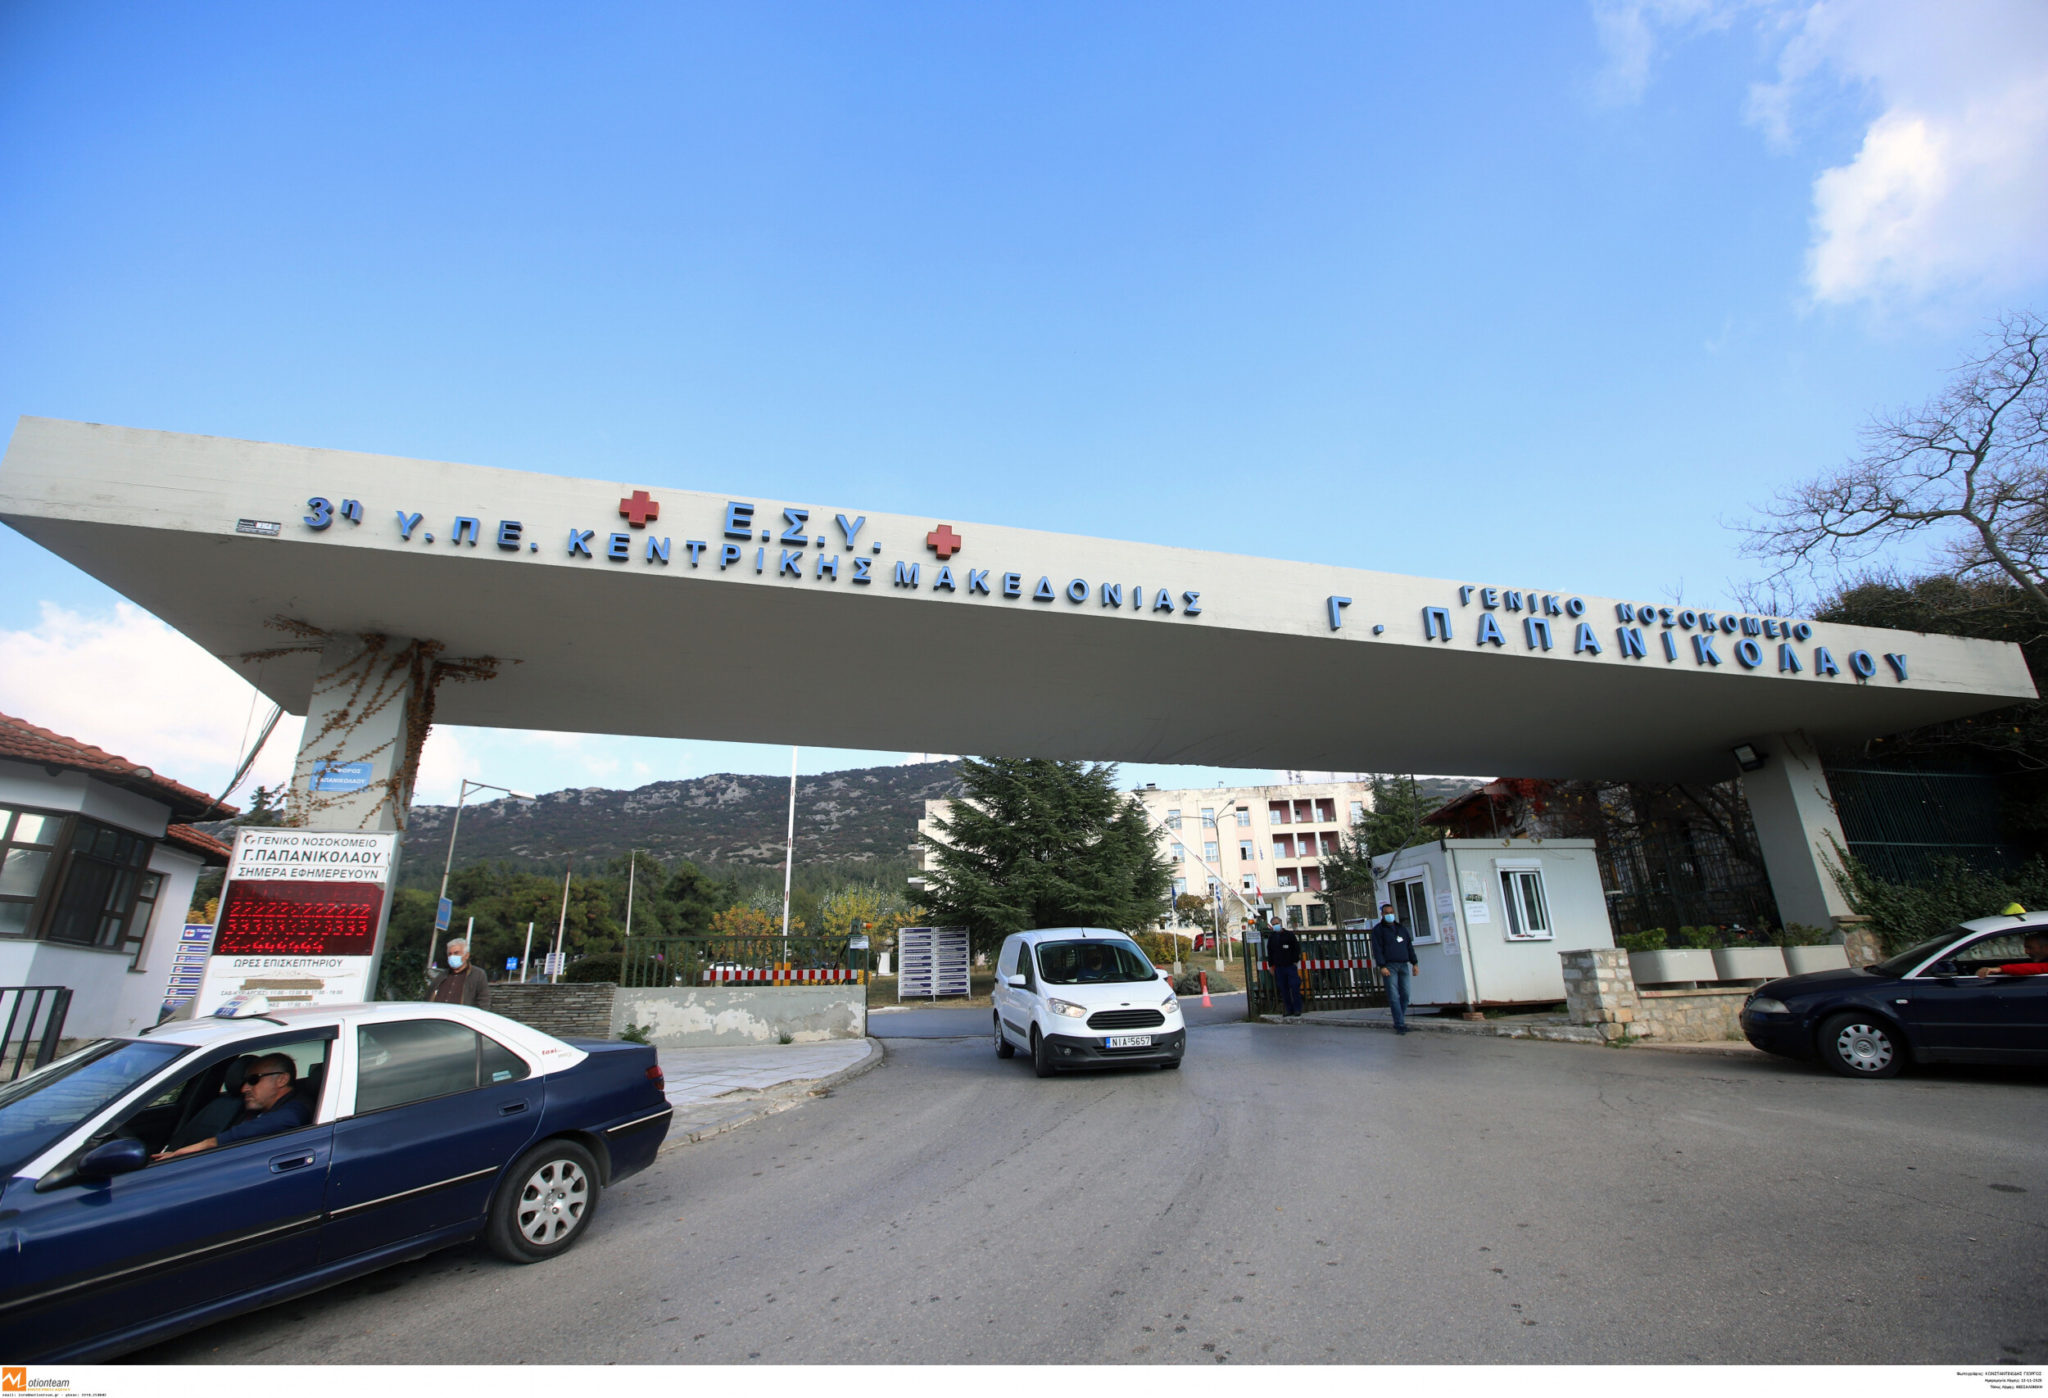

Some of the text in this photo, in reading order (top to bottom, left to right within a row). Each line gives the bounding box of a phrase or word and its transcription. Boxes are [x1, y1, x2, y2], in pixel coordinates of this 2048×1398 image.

[724, 501, 882, 554] Ε.Σ.Υ.
[303, 496, 1202, 616] 3η Υ.ΠΕ. ΚΕΝΤΡΙΚΗΣ ΜΑΚΕΔΟΝΙΑΣ
[1459, 585, 1813, 641] ΓΕΝΙΚΟ ΝΟΣΟΚΟΜΕΙΟ
[1327, 595, 1909, 682] Γ. ΠΑΠΑΝΙΚΟΛΑΟΥ
[242, 849, 382, 864] Γ.ΠΑΠΑΝΙΚΟΛΑΟΥ
[257, 836, 377, 848] ΓΕΝΙΚΟ ΝΟΣΟΚΟΜΕΙΟ
[238, 867, 379, 879] ΣΗΜΕΡΑ ΕΦΗΜΕΡΕΥΟΥΝ
[233, 959, 344, 968] ΩΡΕΣ ΕΠΙΣΚΕΠΤΗΡΙΟΥ
